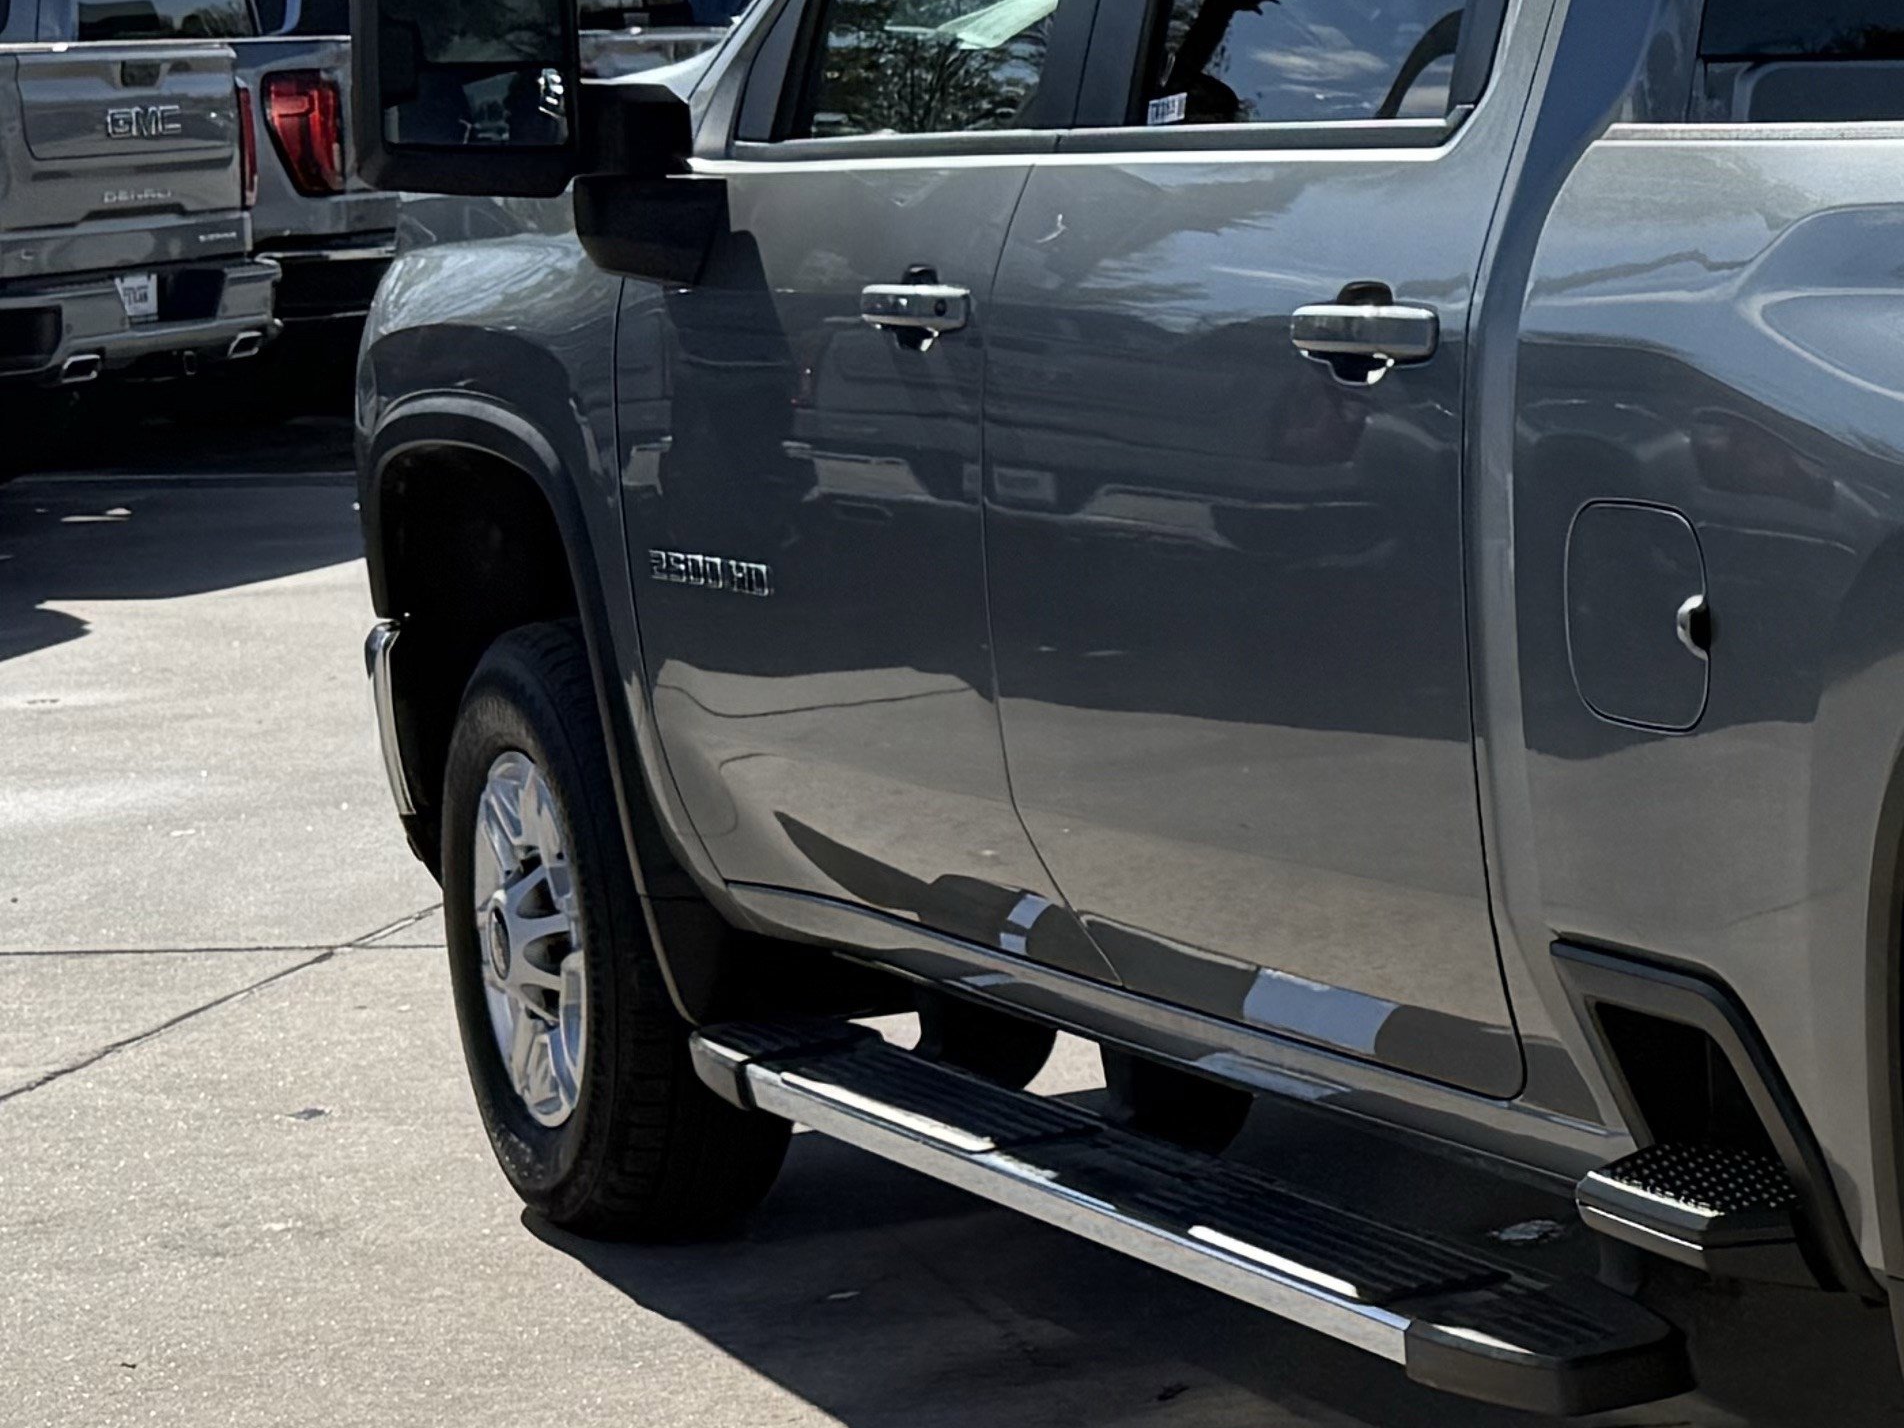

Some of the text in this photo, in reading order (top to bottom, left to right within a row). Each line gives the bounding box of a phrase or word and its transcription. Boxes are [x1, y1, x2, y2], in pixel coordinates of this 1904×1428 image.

[106, 104, 182, 139] GMC
[649, 548, 773, 598] 2500 HD
